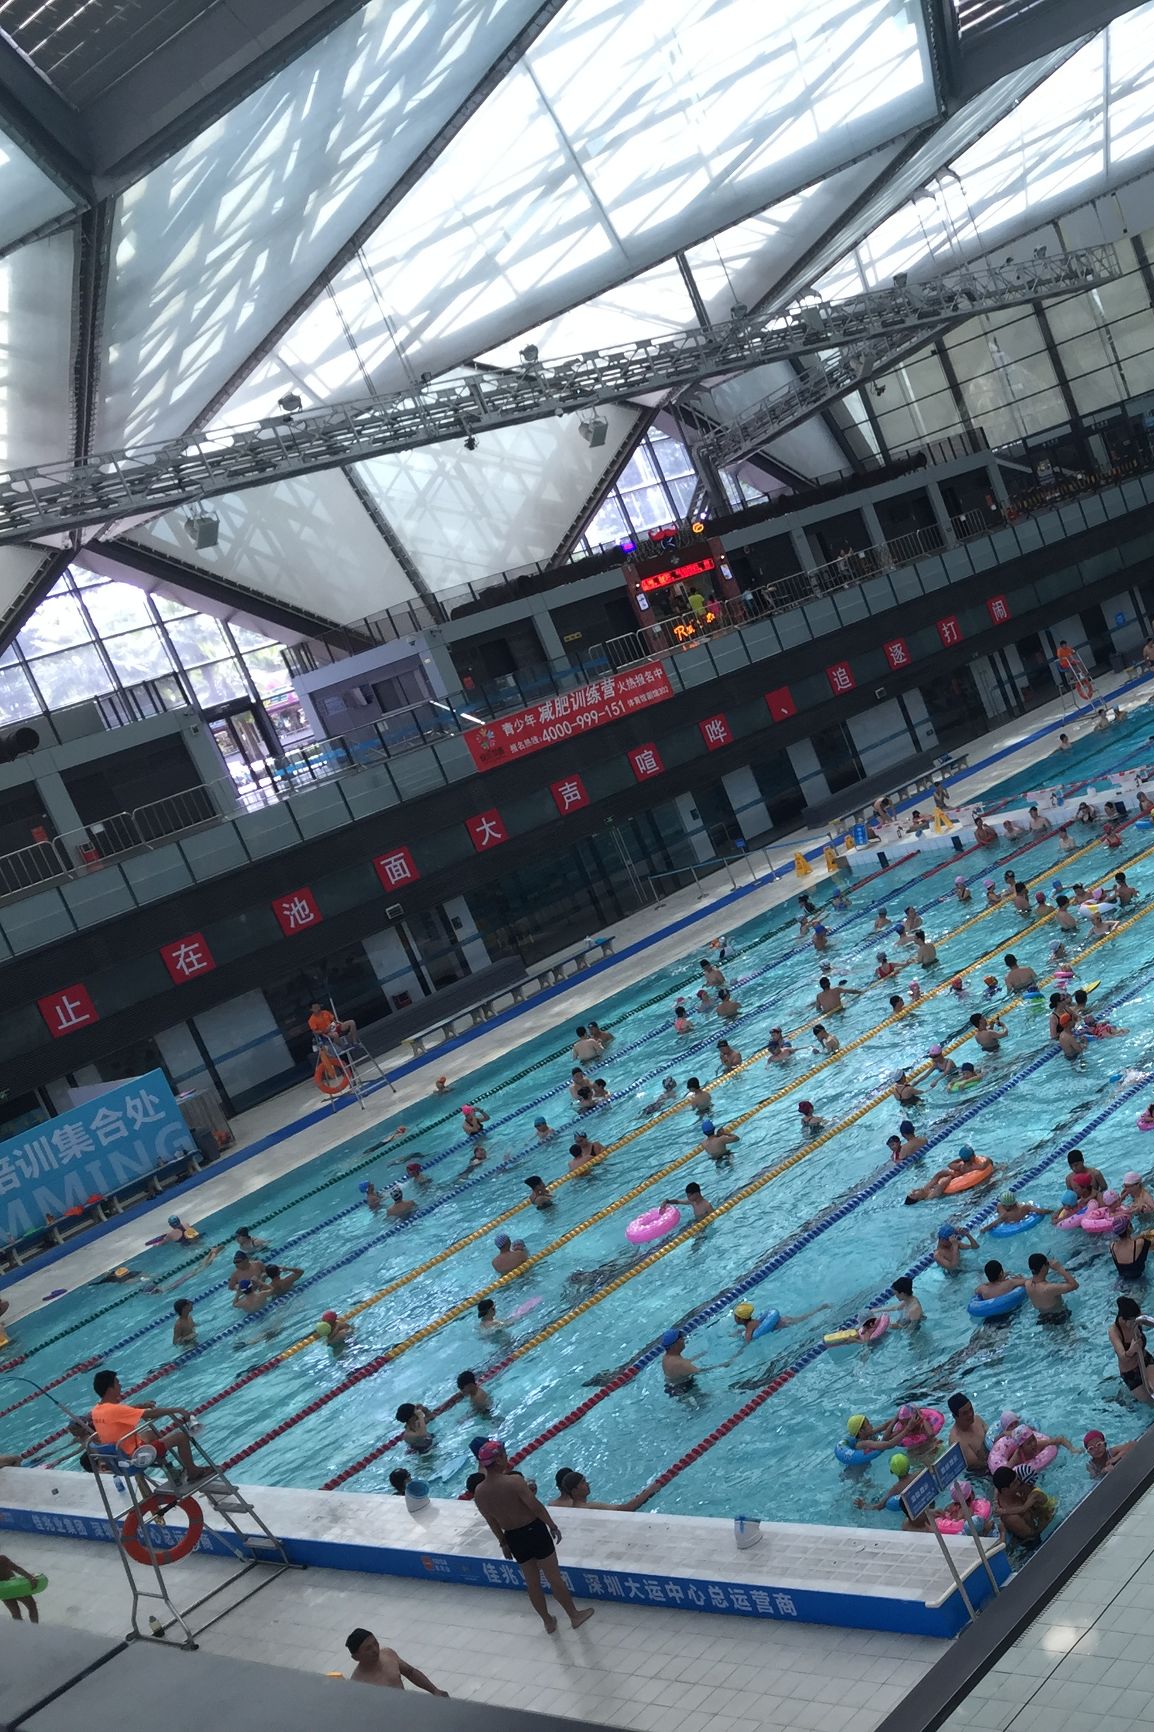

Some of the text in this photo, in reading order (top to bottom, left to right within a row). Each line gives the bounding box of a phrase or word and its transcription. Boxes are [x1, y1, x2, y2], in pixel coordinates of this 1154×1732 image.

[501, 667, 663, 737] 青少年 减肥训练营 火热报名中
[542, 700, 626, 743] 4000-999-151
[56, 996, 90, 1031] 止
[172, 943, 208, 976] 在
[282, 897, 315, 928] 池
[380, 853, 412, 886] 面
[476, 818, 502, 846] 大
[560, 781, 584, 811] 声
[635, 749, 660, 776] 喧
[705, 719, 727, 744] 哗
[832, 668, 853, 690] 追
[889, 643, 908, 666] 逐
[941, 620, 959, 643] 打
[992, 600, 1006, 621] 闹
[583, 1573, 798, 1617] 深圳大运中心总运营商
